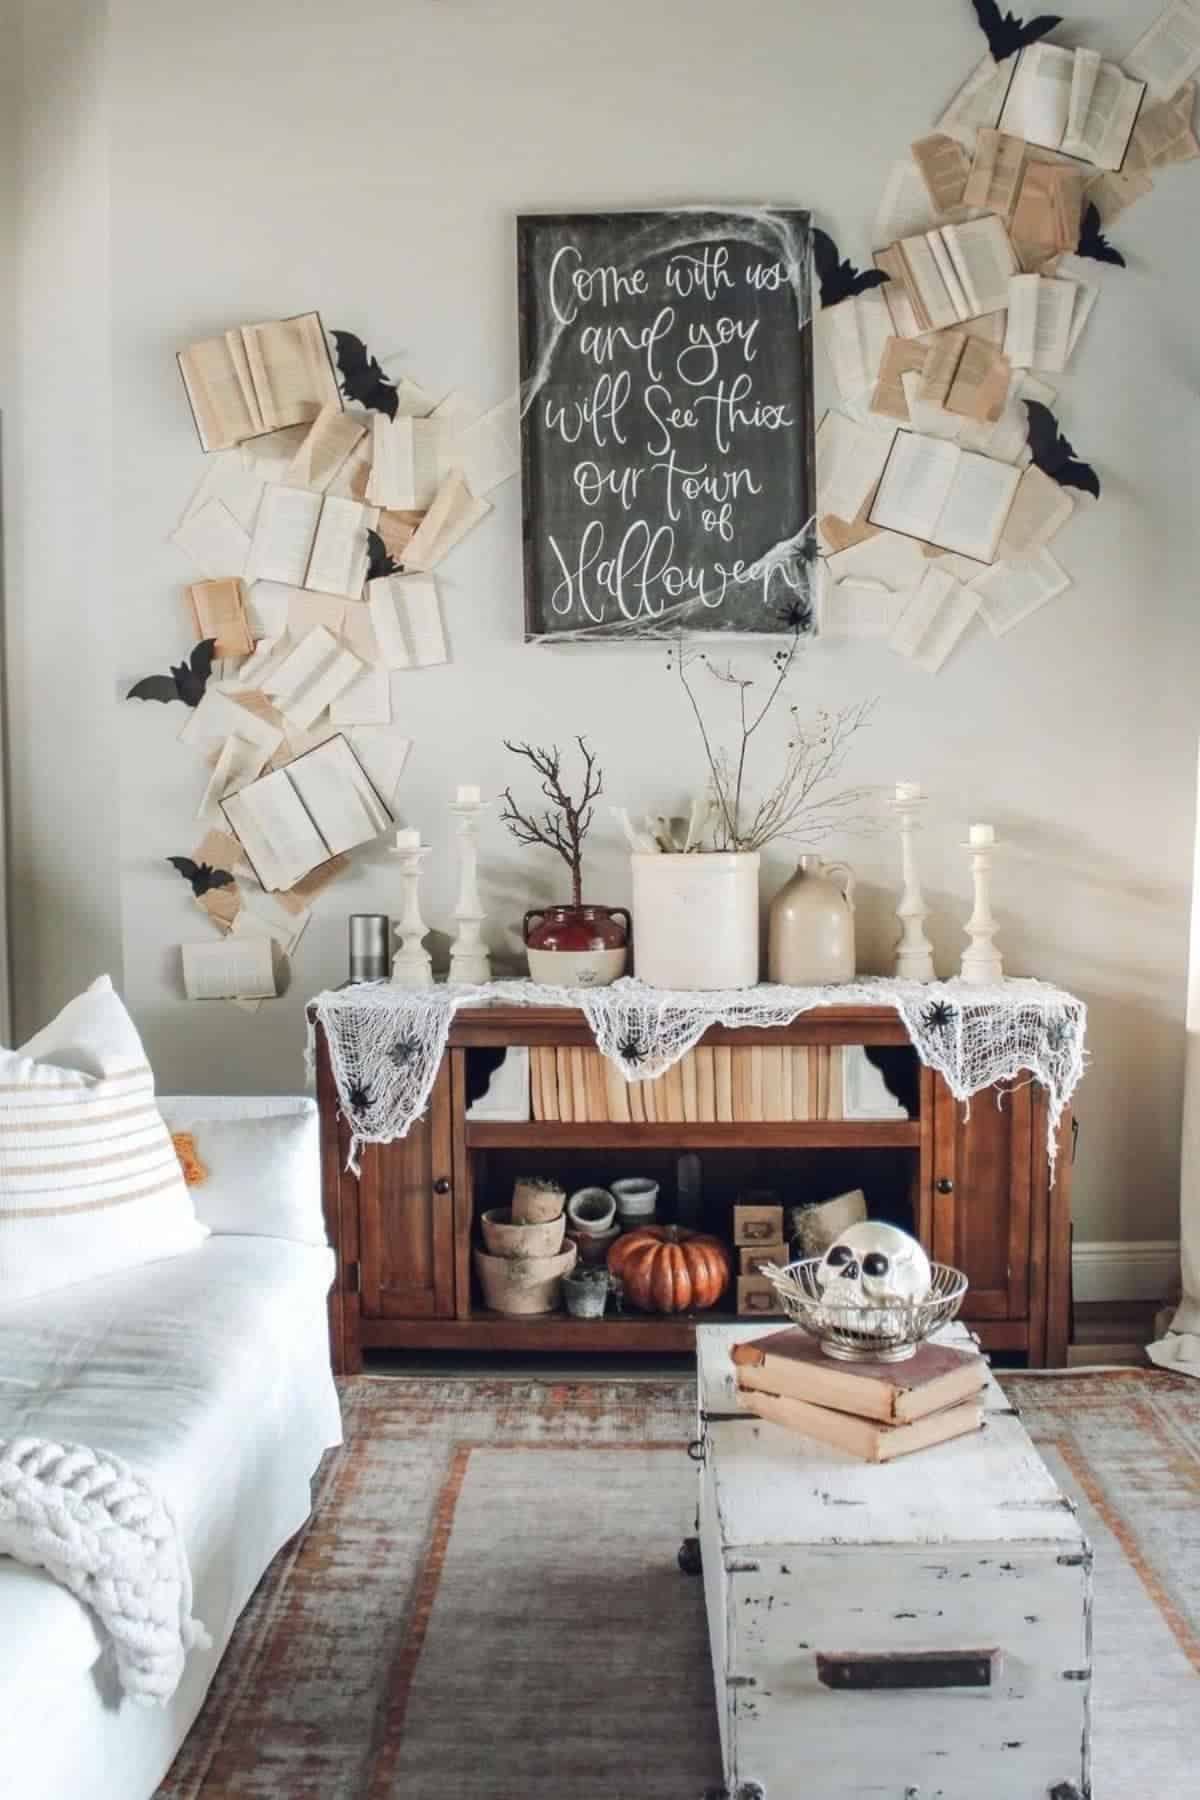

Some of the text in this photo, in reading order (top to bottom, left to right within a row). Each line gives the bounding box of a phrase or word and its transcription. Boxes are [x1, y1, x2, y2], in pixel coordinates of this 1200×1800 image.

[549, 245, 649, 325] Come
[666, 247, 736, 301] with
[580, 307, 760, 386] and you
[544, 370, 794, 456] will See this
[702, 503, 735, 542] of
[549, 519, 799, 622] Halloween
